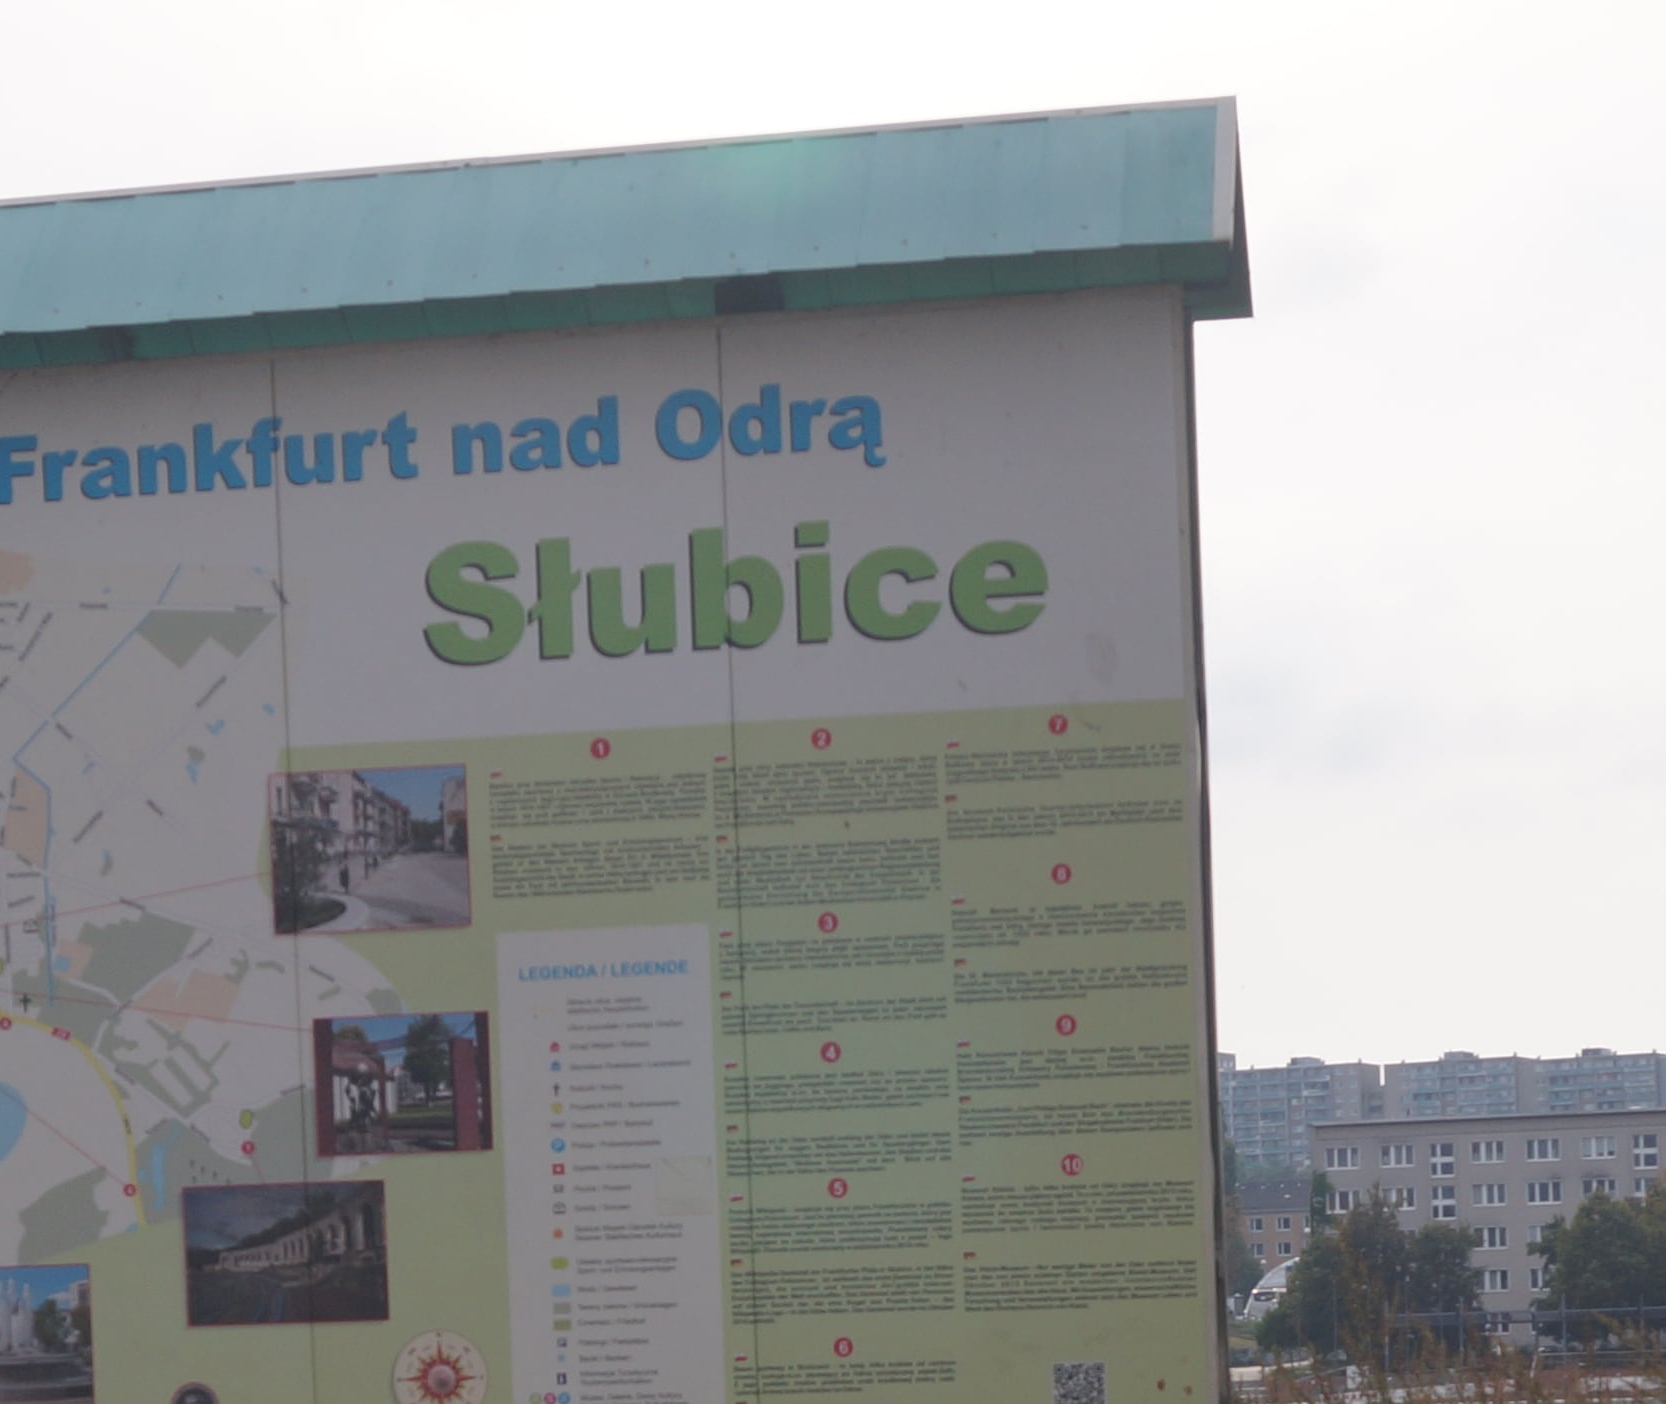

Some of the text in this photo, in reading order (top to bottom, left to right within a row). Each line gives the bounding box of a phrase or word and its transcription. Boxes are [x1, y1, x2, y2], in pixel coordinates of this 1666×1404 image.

[451, 395, 619, 474] nad
[654, 384, 887, 468] Odrą
[422, 520, 1050, 665] Słubice
[518, 963, 598, 981] LEGENDA
[610, 960, 689, 977] LEGENDE
